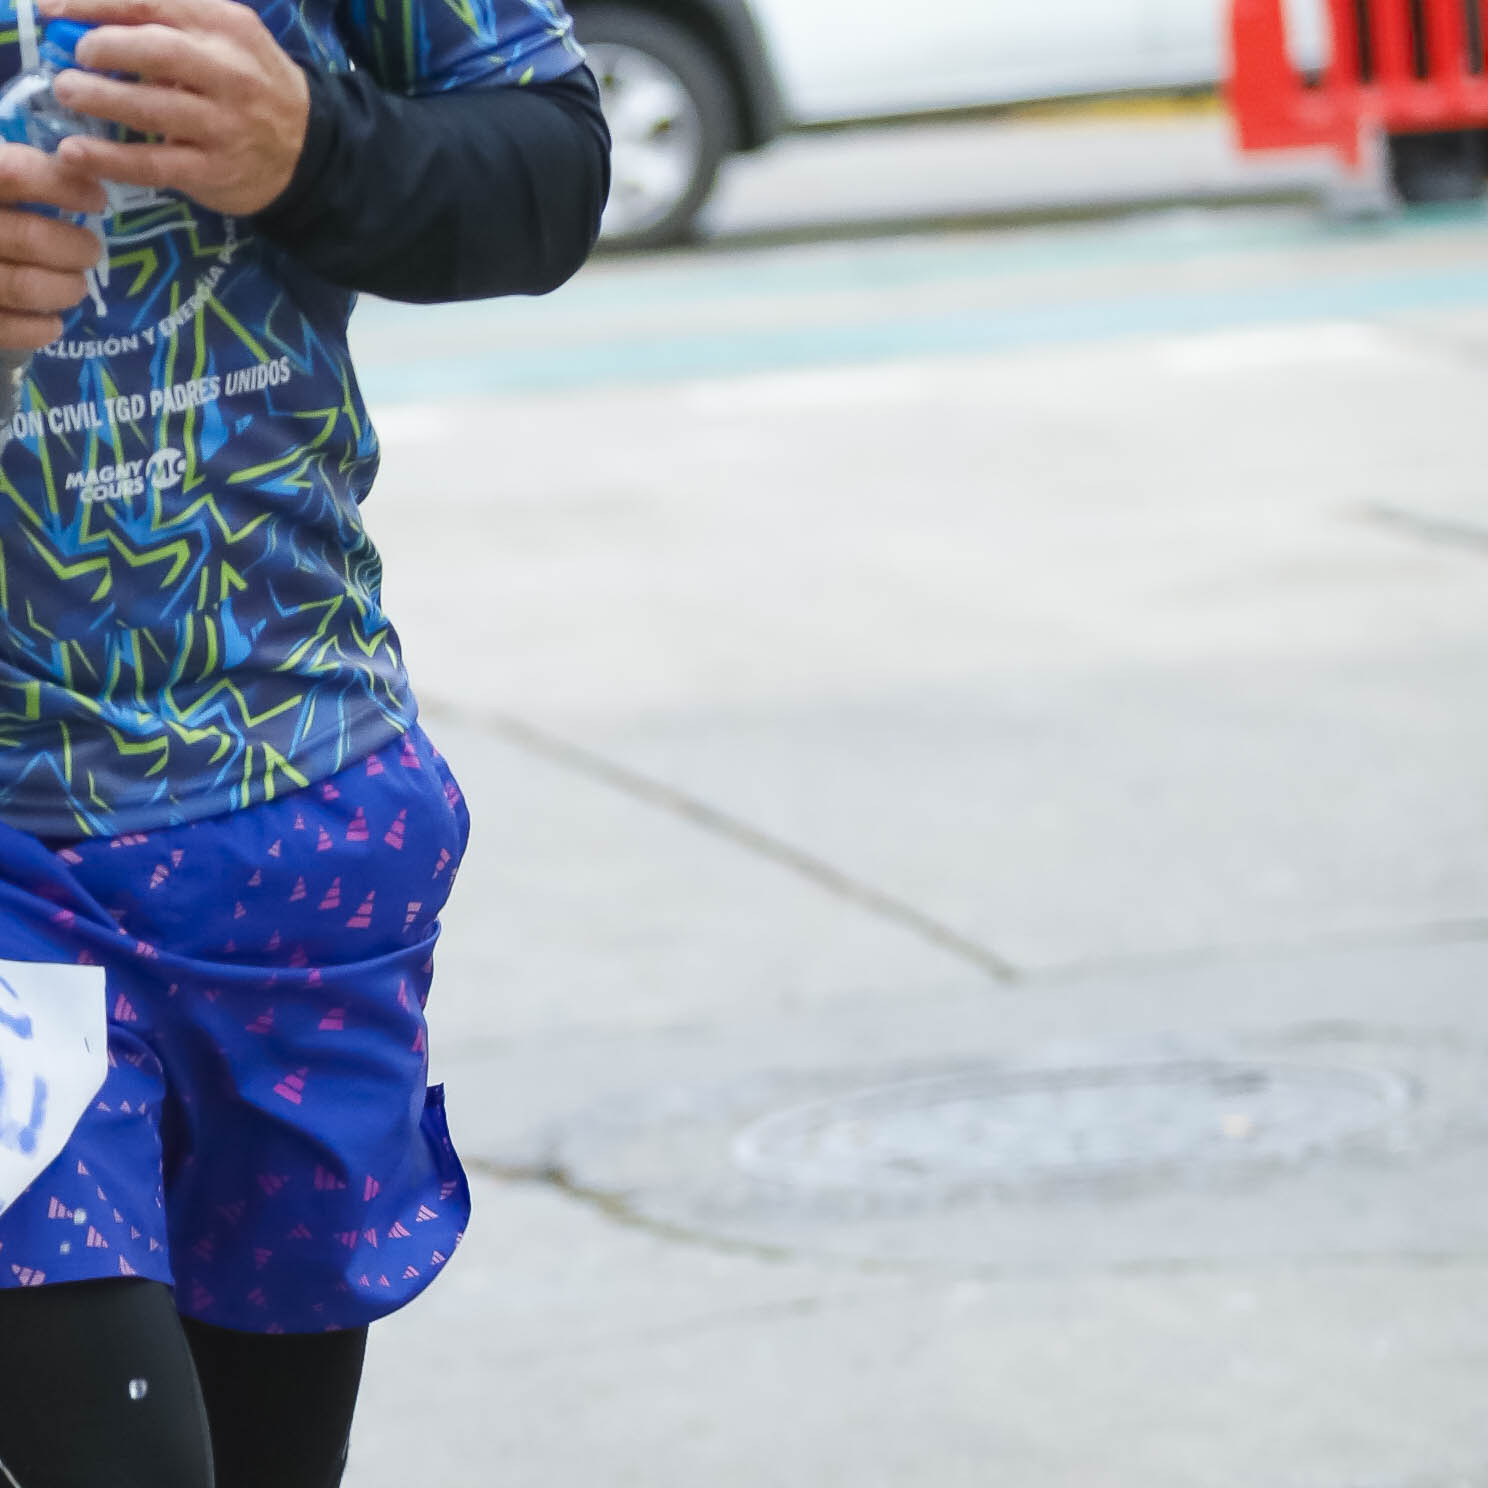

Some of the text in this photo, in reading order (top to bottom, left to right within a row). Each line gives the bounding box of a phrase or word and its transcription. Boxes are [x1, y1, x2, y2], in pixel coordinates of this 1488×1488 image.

[36, 334, 139, 359] CLUSIÓN
[48, 401, 103, 435] CIVIL
[149, 375, 221, 415] PADRES
[224, 355, 292, 396] UNIDOS
[65, 459, 144, 491] MAGNY
[79, 475, 145, 503] COURS
